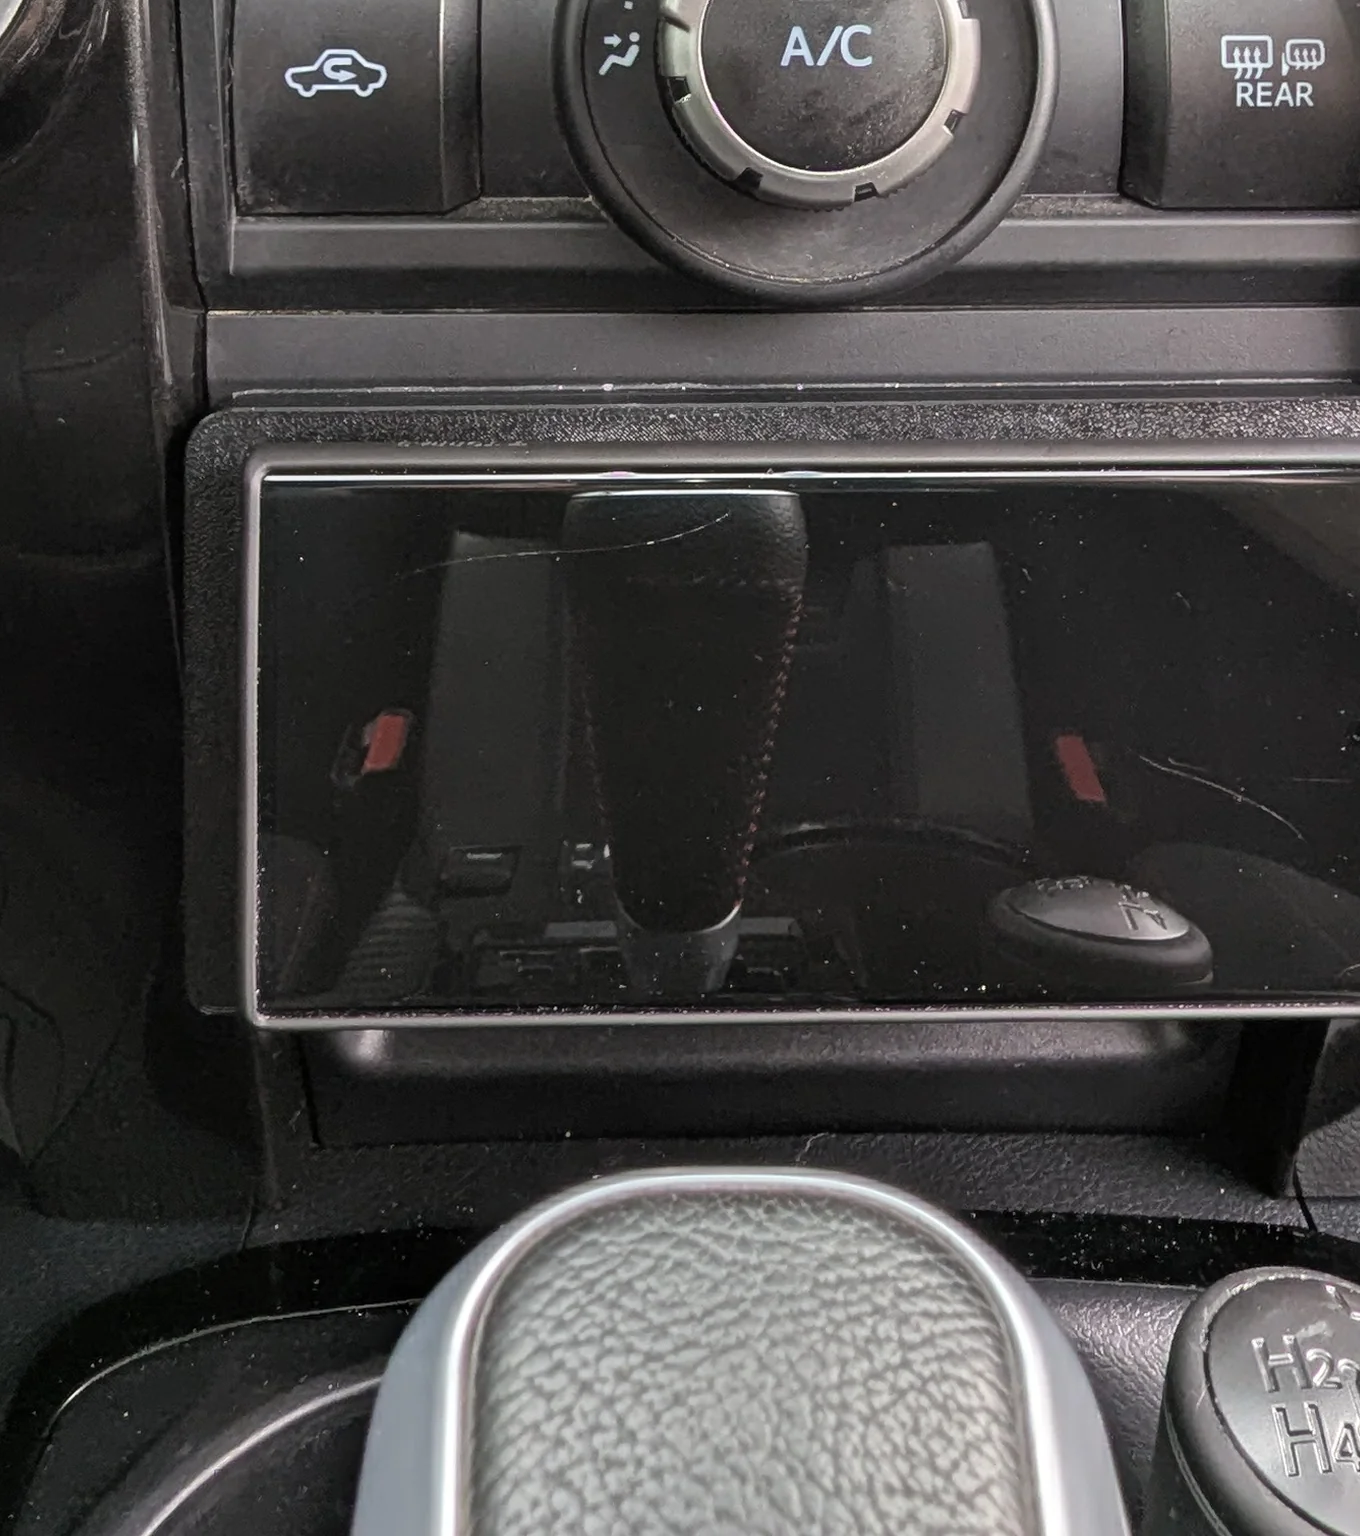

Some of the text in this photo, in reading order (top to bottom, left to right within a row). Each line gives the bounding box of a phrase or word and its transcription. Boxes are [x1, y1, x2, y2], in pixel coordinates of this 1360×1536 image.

[779, 23, 874, 68] A/C
[1234, 80, 1314, 107] REAR
[1250, 1333, 1344, 1393] H2
